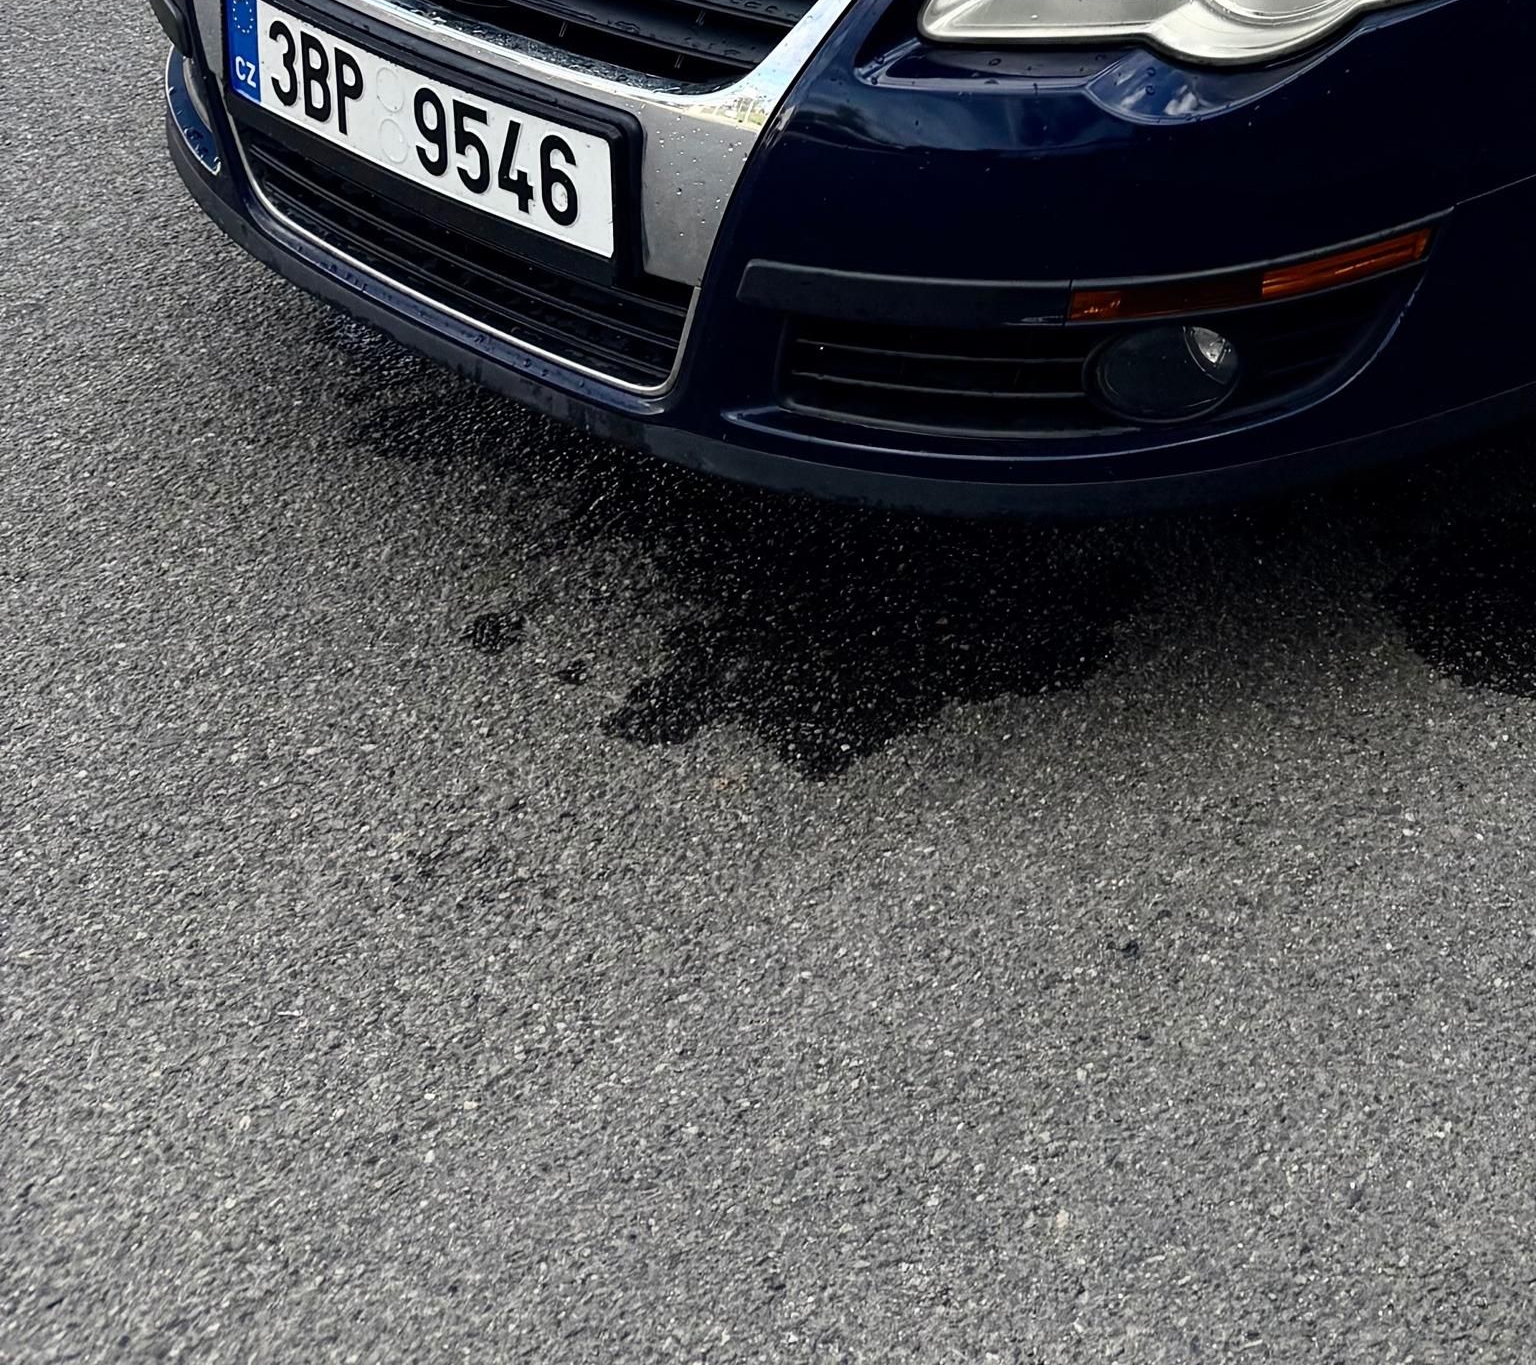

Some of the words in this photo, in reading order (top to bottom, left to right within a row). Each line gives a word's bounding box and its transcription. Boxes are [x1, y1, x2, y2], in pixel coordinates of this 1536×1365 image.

[235, 55, 257, 88] CZ
[269, 20, 363, 135] 3BP
[413, 87, 578, 227] 9546
